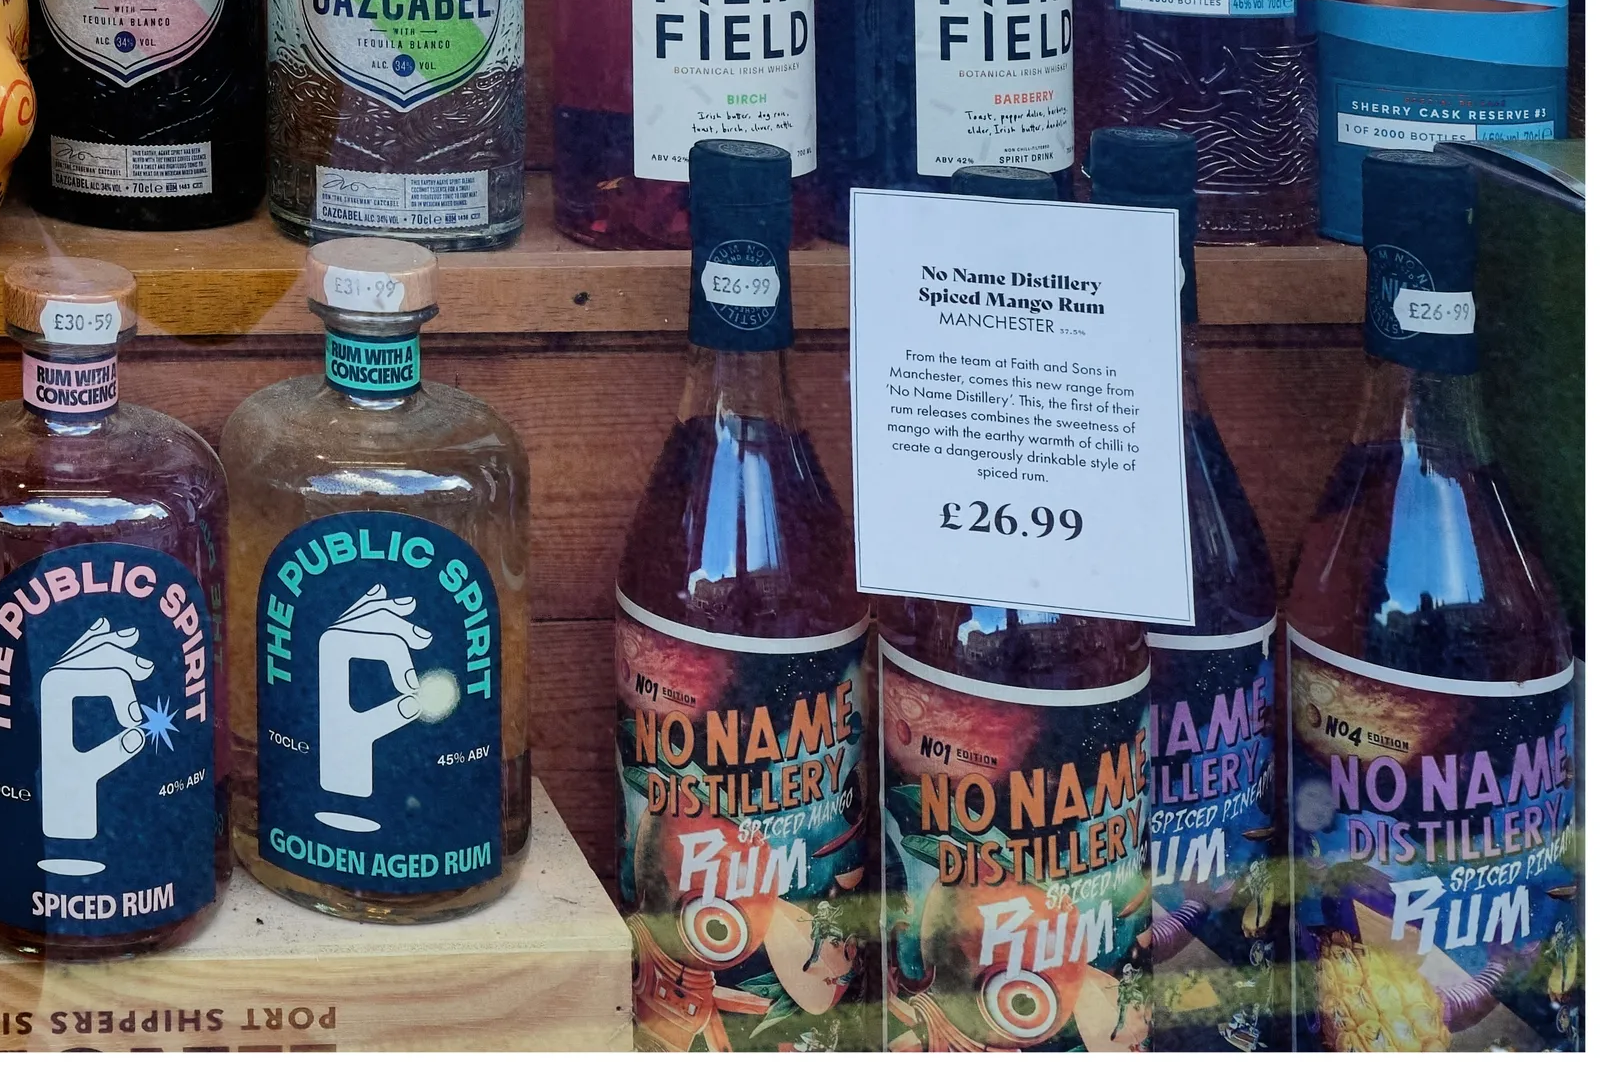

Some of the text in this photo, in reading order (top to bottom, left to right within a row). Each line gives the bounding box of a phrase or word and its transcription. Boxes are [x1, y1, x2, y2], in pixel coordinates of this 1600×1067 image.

[83, 15, 170, 26] TEQUILA BLANCO
[656, 9, 807, 61] FIELD
[727, 94, 767, 104] BIRCH
[995, 90, 1053, 105] BARBERRY
[999, 152, 1053, 164] SPIRIT DRINK
[922, 265, 1101, 296] No Name Distillery
[919, 287, 1105, 315] Spiced Mango Rum
[946, 446, 1118, 472] dangerously drinkable style
[940, 500, 1083, 541] £26.99
[159, 583, 206, 724] SPIRIT
[635, 679, 853, 765] NO NAME
[159, 768, 206, 797] 40% ABV
[647, 747, 845, 817] DISTILLERY
[1330, 726, 1568, 812] NO NAME
[269, 826, 491, 879] GOLDEN AGED RUM
[32, 882, 174, 919] SPICED RUM
[52, 1009, 223, 1034] SHIPPERS
[240, 1008, 336, 1030] PORT
